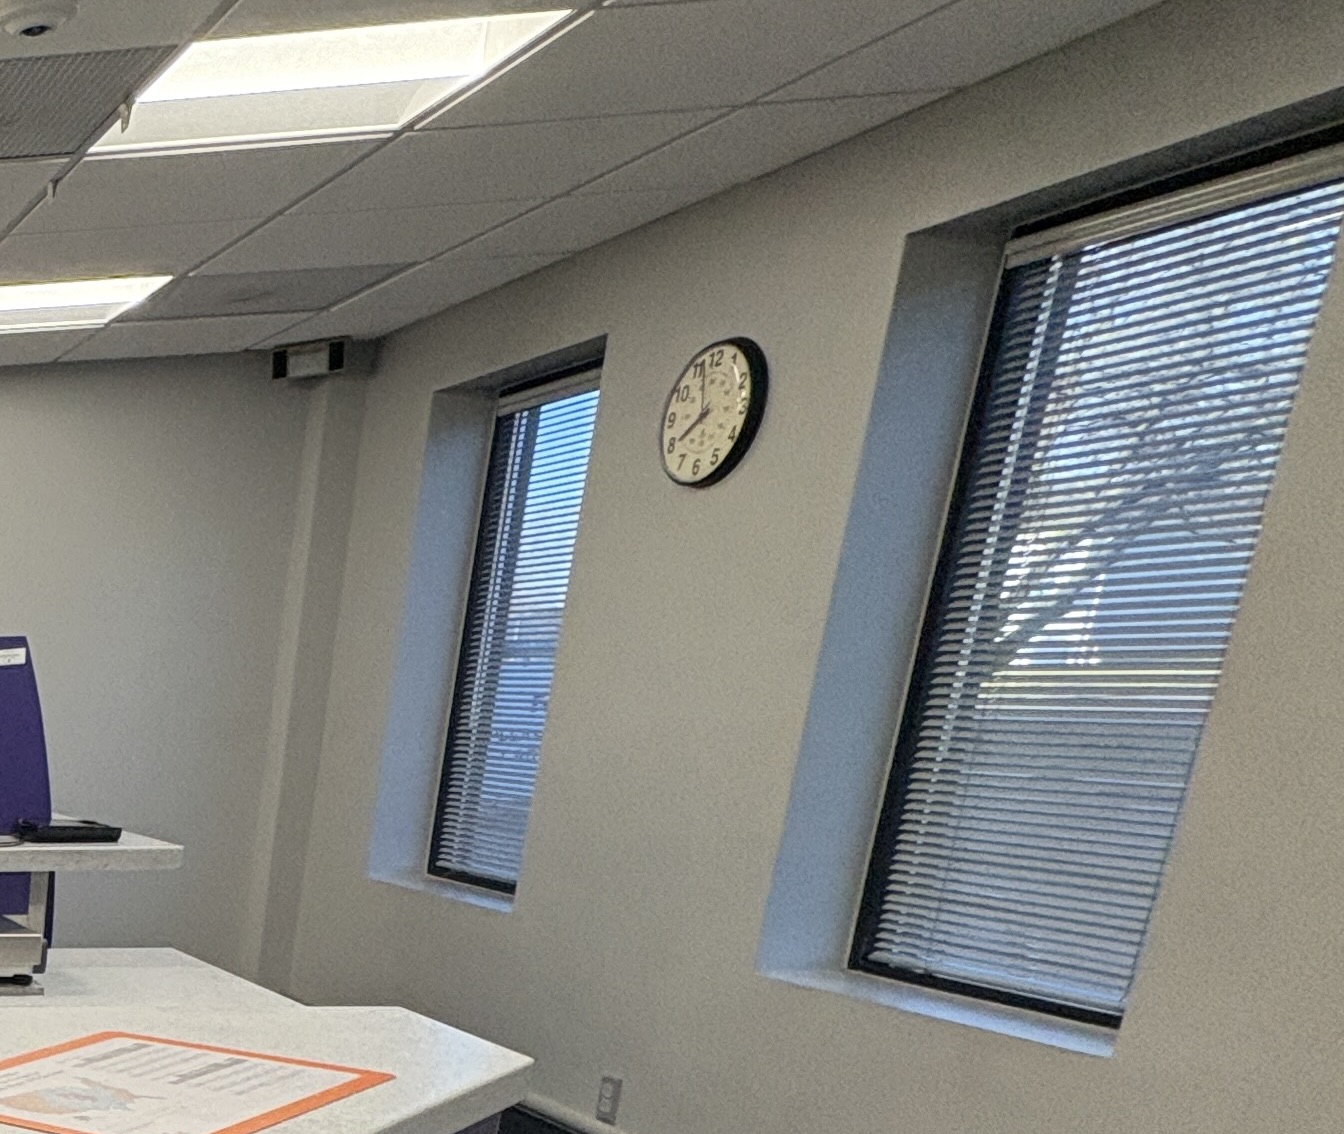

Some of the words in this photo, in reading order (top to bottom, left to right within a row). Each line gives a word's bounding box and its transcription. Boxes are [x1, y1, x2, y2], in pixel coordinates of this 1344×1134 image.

[709, 349, 724, 367] 12
[731, 353, 737, 365] 1
[693, 358, 706, 378] 11
[738, 373, 747, 390] 2
[675, 385, 689, 402] 10
[667, 412, 676, 428] 9
[728, 425, 737, 442] 4
[667, 437, 676, 454] 8
[677, 454, 687, 470] 7
[710, 448, 720, 466] 5
[692, 459, 701, 476] 6
